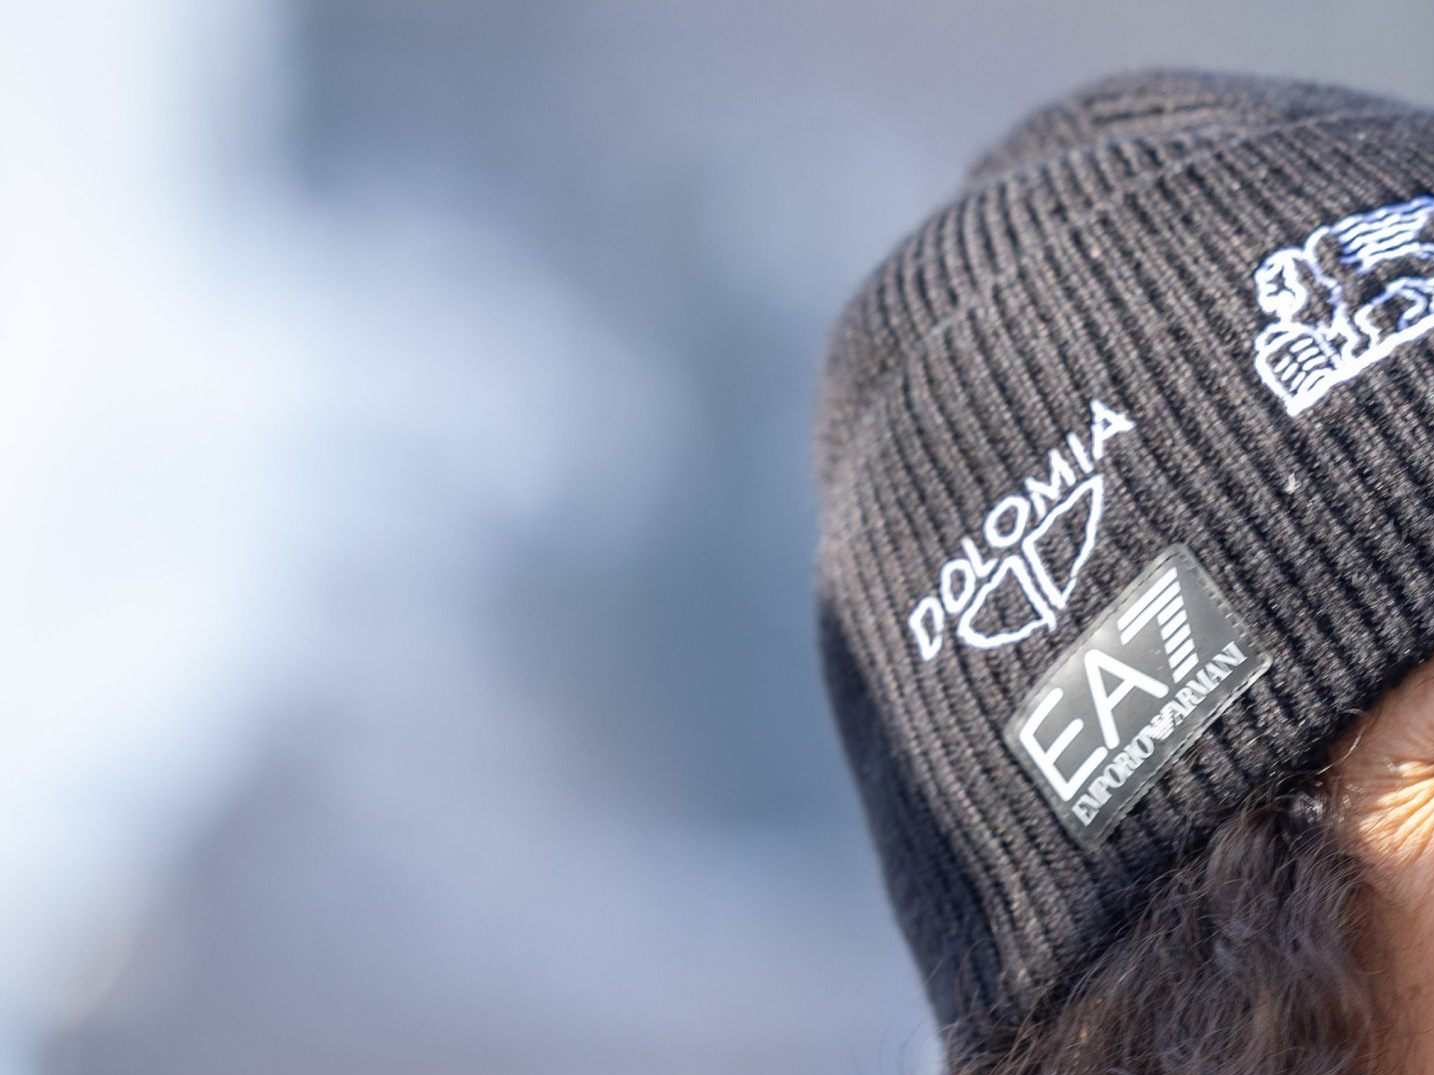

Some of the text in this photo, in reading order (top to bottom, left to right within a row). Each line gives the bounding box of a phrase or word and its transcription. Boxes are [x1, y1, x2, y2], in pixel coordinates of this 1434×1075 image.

[908, 400, 1136, 661] DOLOMIA
[1018, 567, 1200, 802] EA7
[1071, 641, 1248, 827] EMPORIO ARMANI
